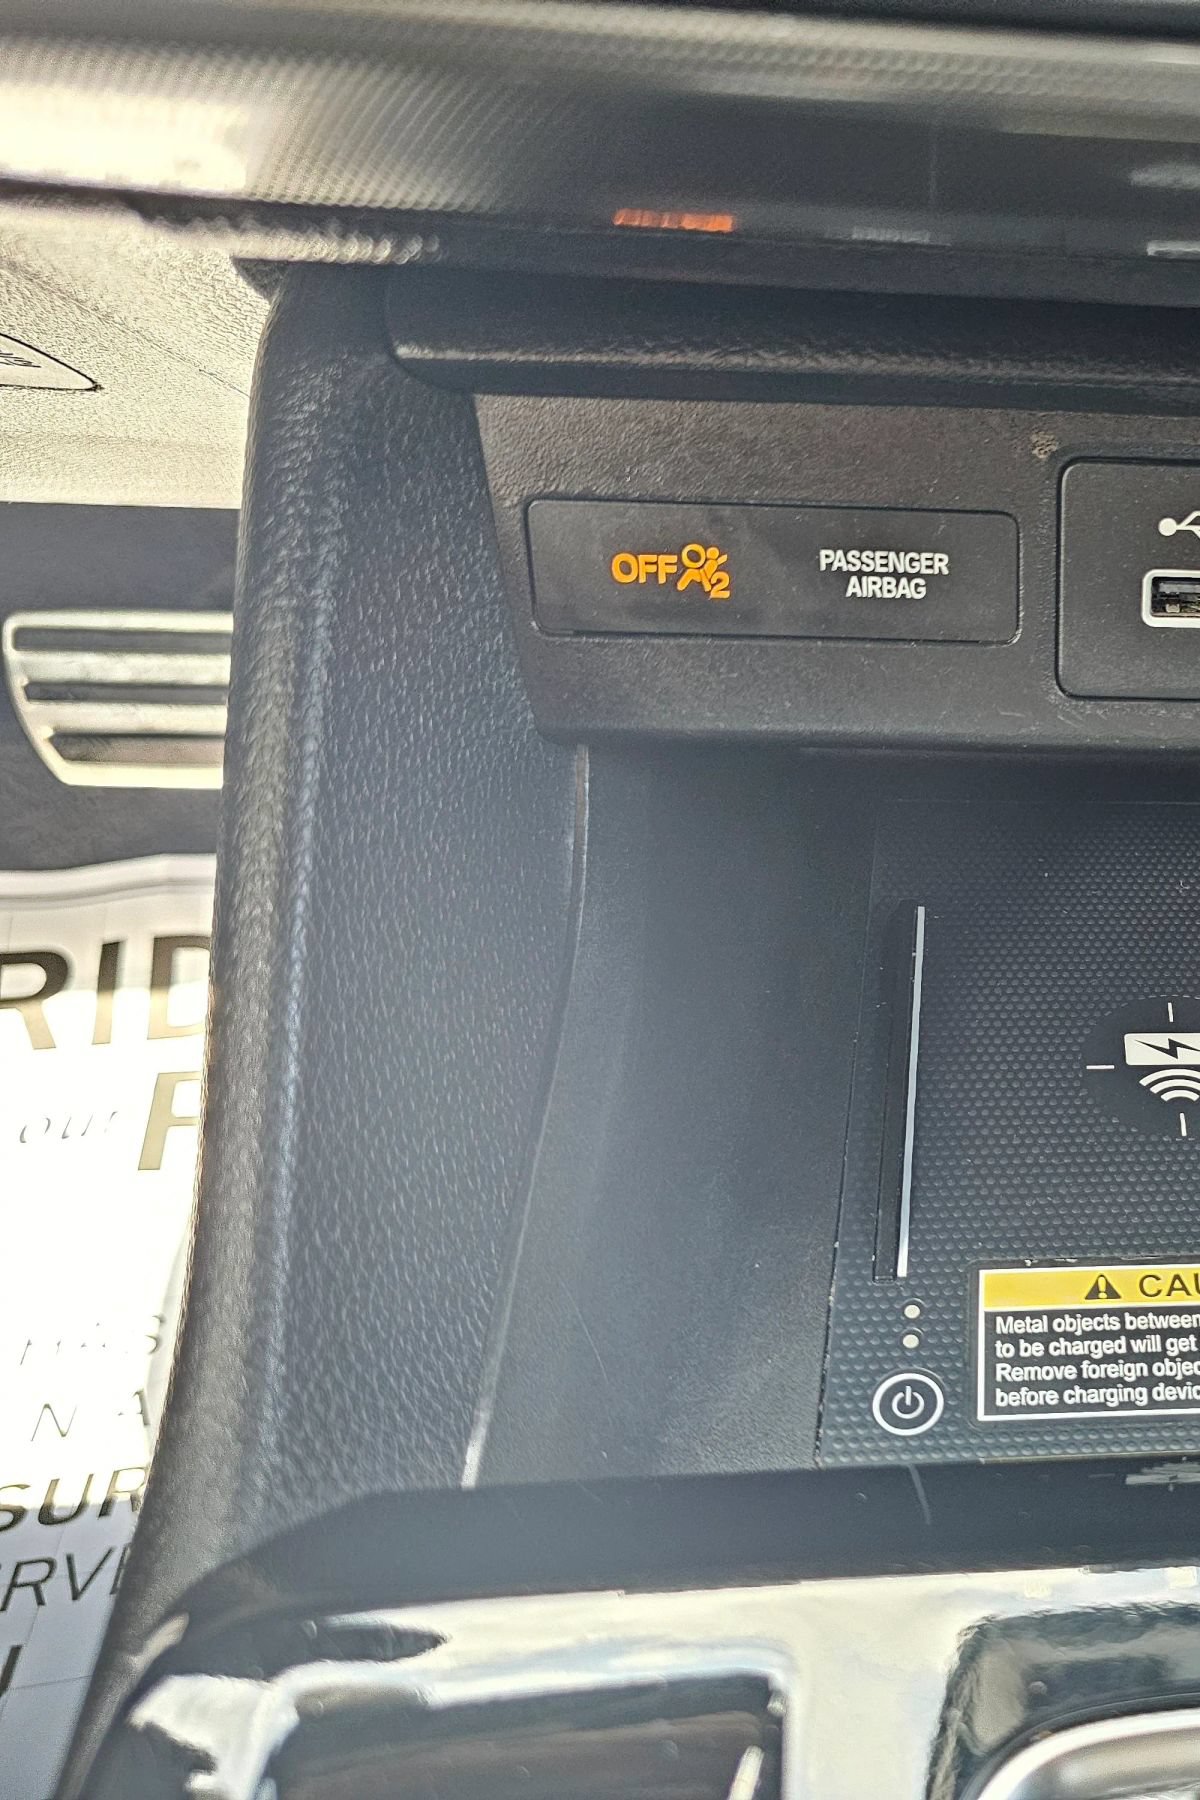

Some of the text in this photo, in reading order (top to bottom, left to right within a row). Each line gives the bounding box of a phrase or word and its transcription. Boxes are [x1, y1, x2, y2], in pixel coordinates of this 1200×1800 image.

[610, 552, 679, 585] OFF
[818, 548, 950, 577] PASSENGER
[845, 576, 928, 600] AIRBAG
[994, 1314, 1048, 1334] Metal
[1052, 1313, 1121, 1335] objects
[994, 1339, 1016, 1358] to
[1019, 1338, 1045, 1357] be
[1048, 1336, 1127, 1359] charged
[1130, 1334, 1162, 1354] will
[1165, 1333, 1197, 1356] get
[995, 1362, 1077, 1382] Remove
[1080, 1359, 1149, 1382] foreign
[995, 1387, 1059, 1407] before
[1062, 1384, 1148, 1407] charging
